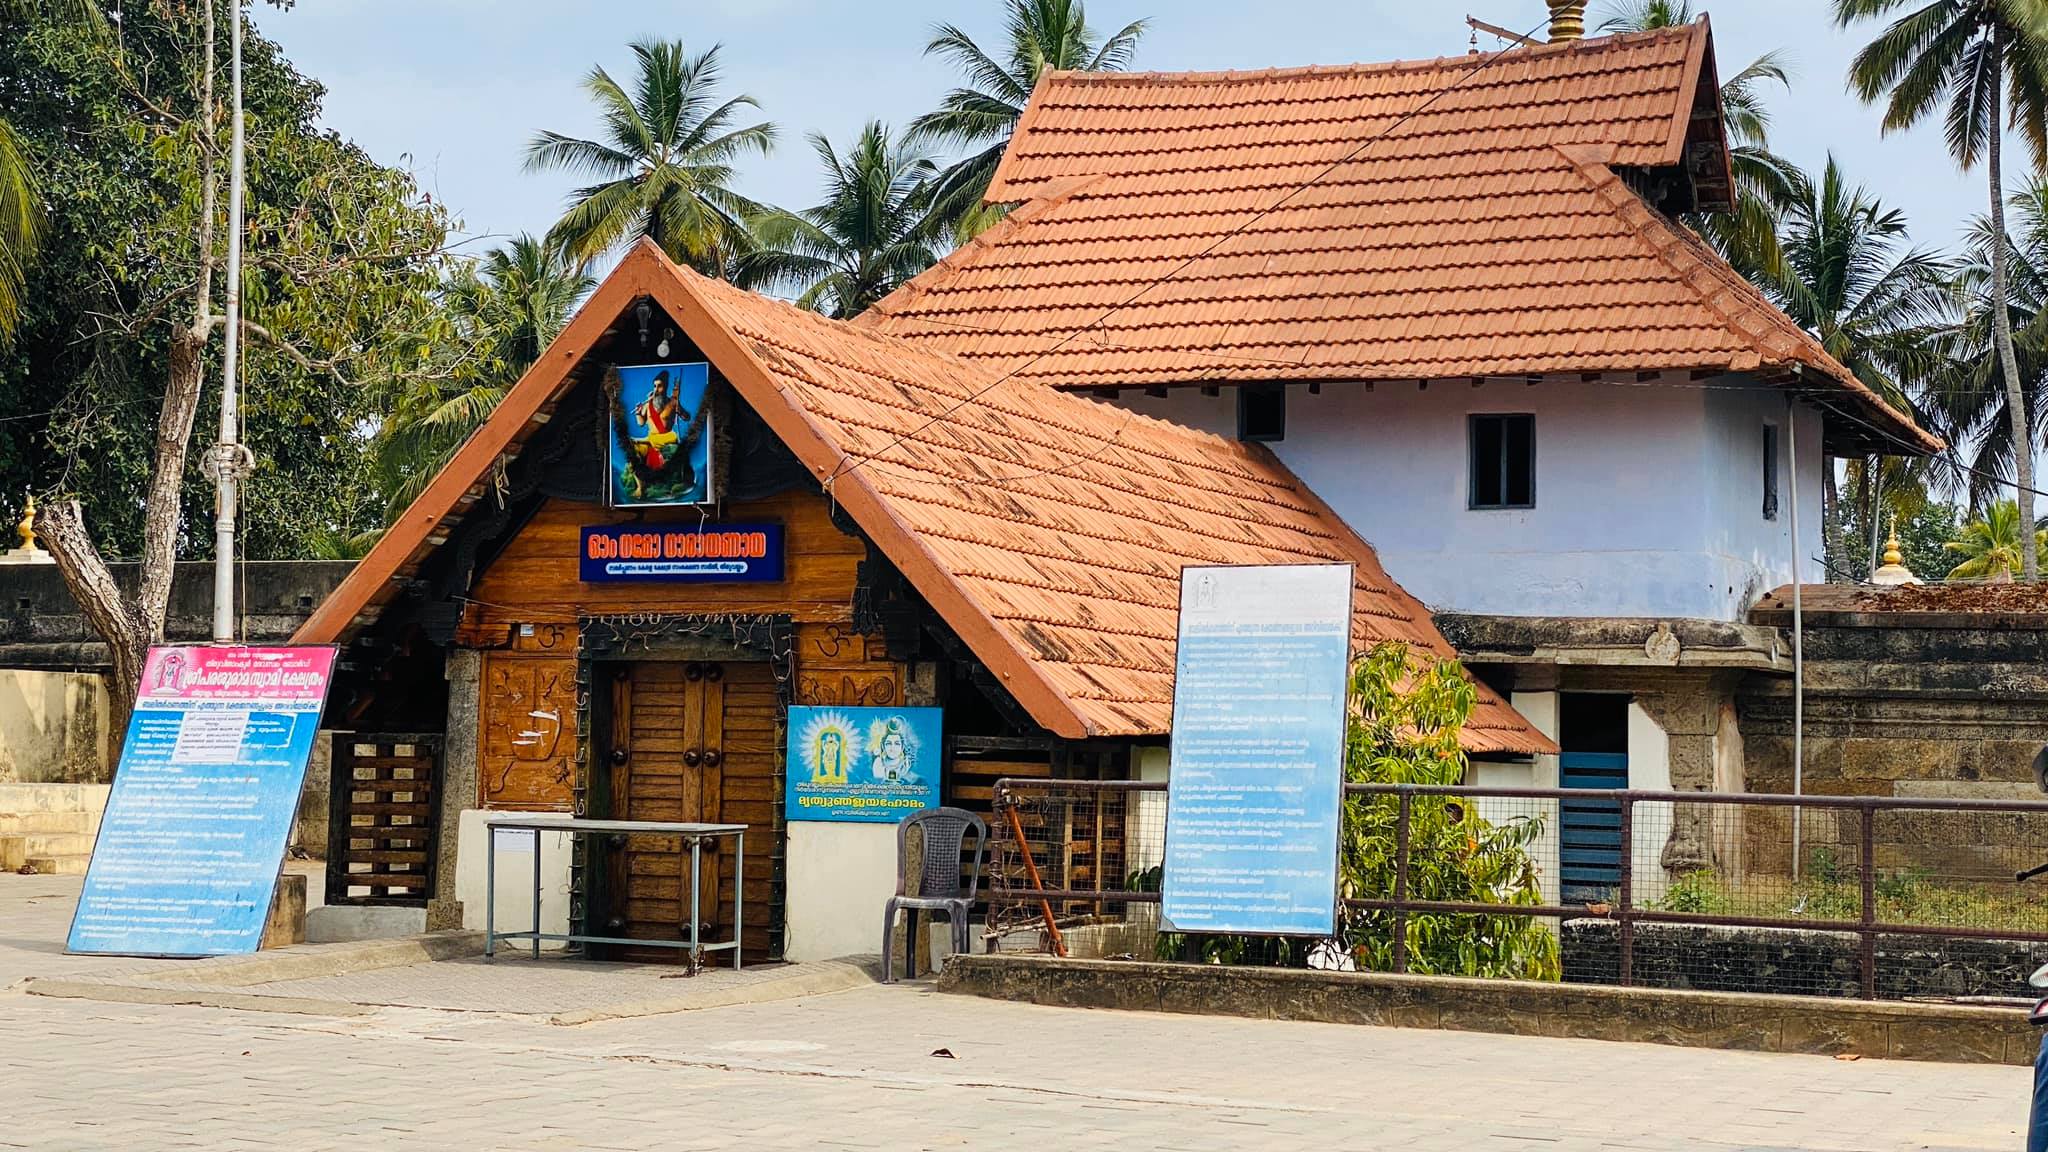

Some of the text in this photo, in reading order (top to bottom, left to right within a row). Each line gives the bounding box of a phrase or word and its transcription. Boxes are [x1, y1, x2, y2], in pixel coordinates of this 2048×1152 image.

[588, 532, 766, 559] ഓം നമോ നാരായണായ
